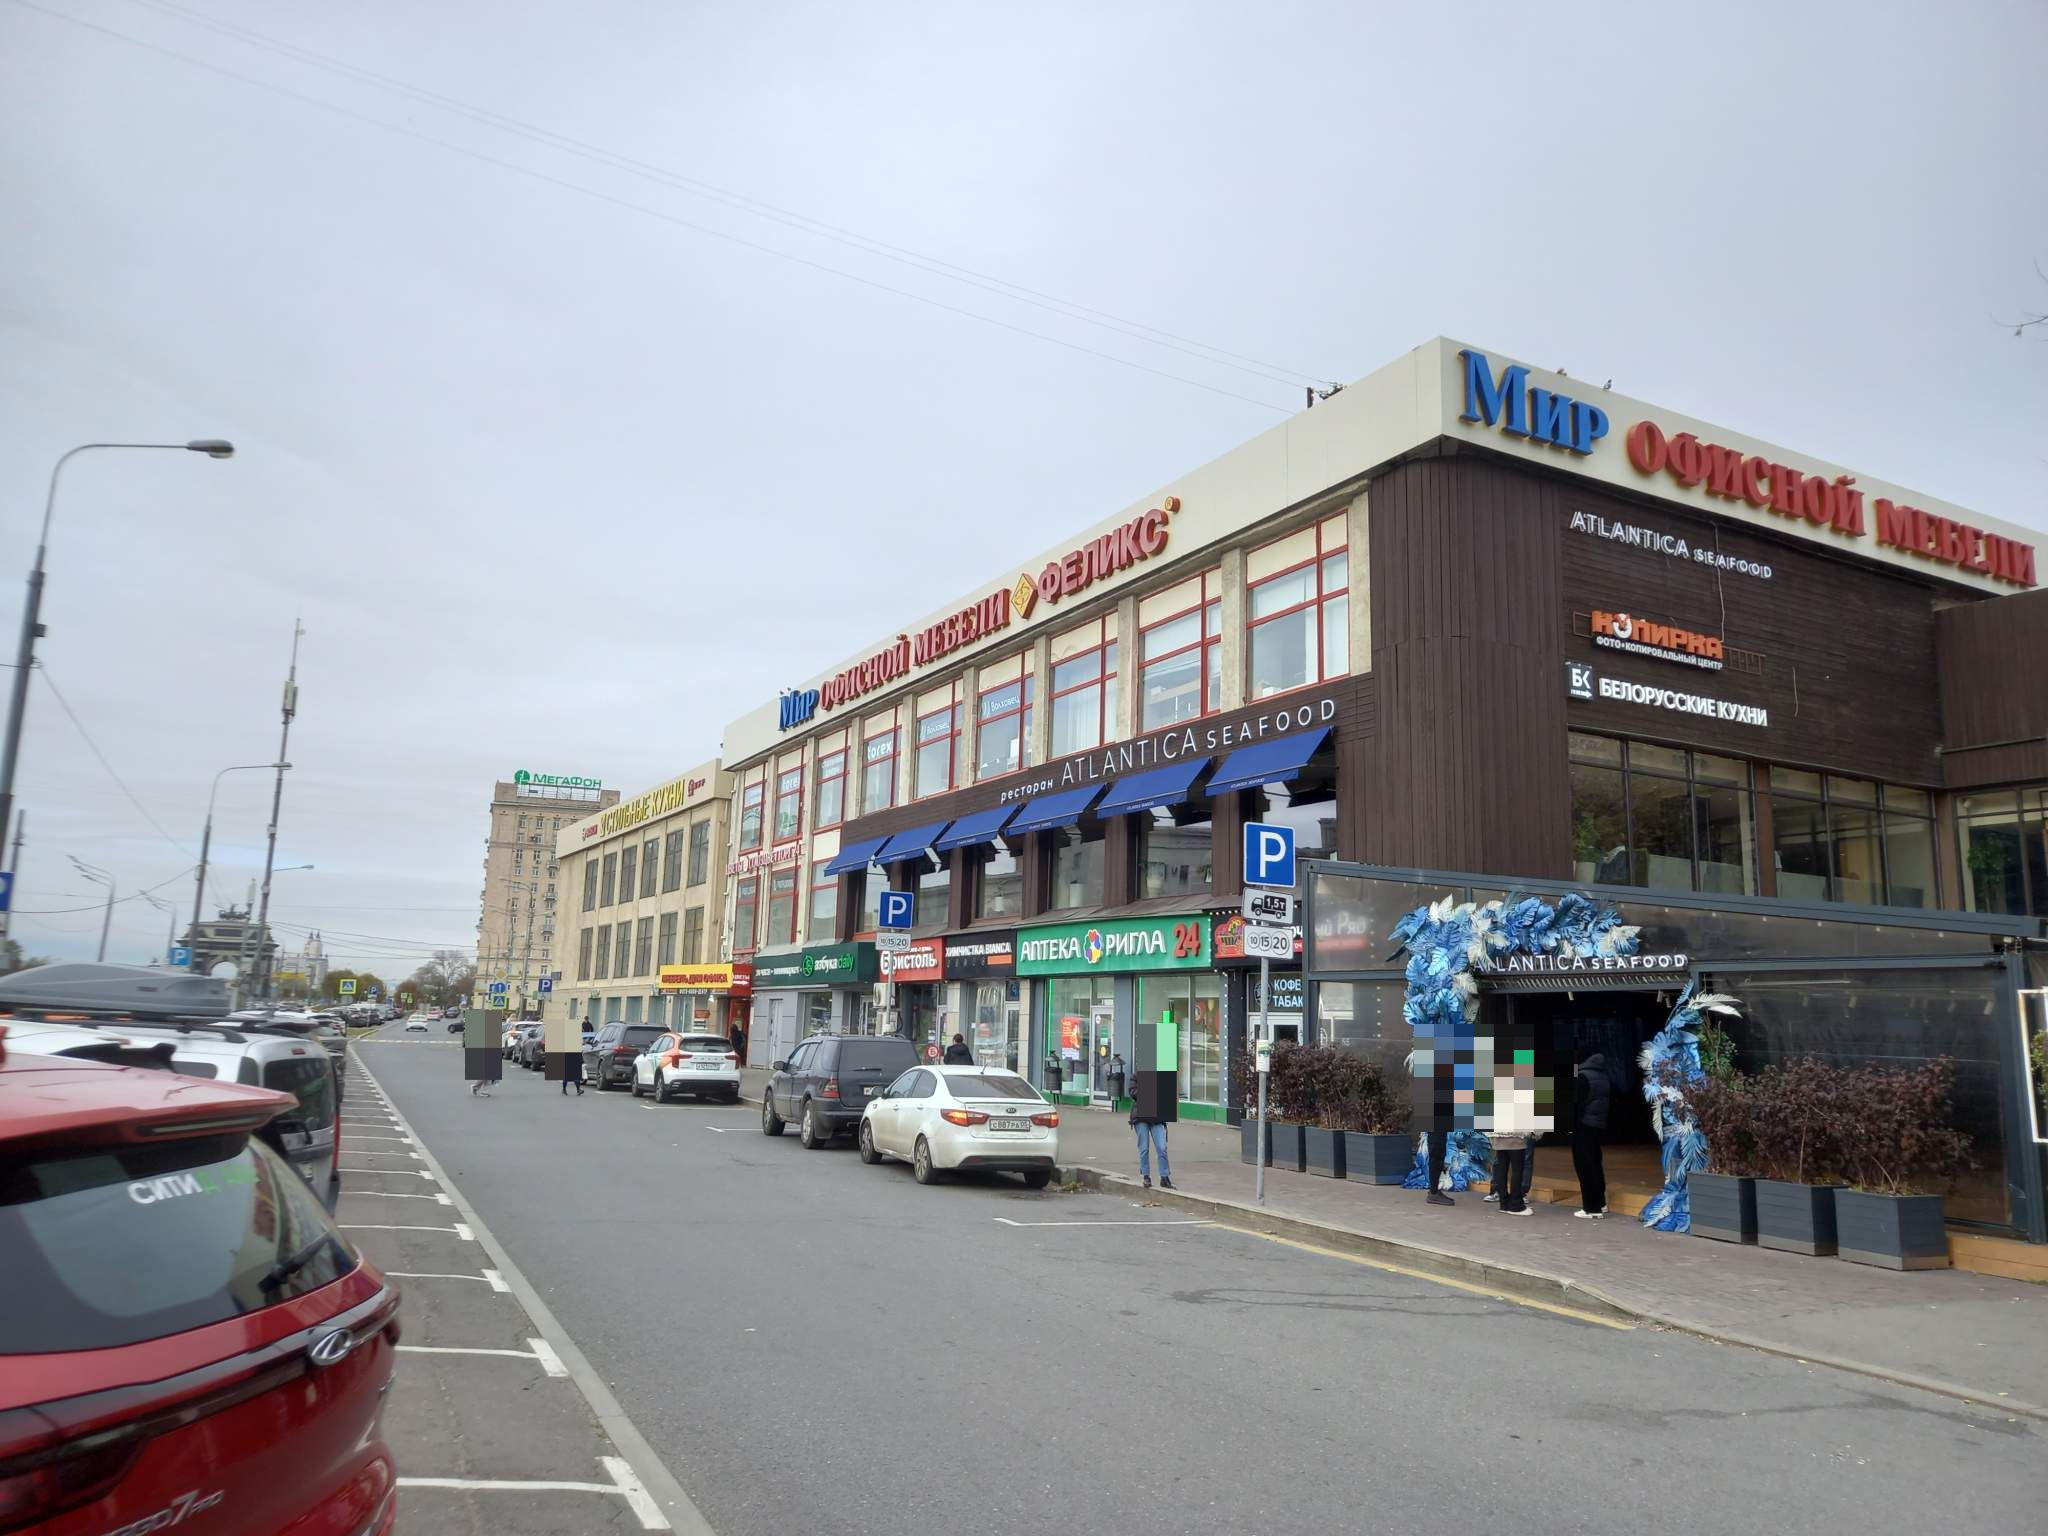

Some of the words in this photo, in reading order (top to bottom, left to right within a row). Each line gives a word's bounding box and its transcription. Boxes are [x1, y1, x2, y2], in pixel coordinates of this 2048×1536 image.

[1627, 420, 1866, 537] ОФИСНОЙ
[1875, 498, 2038, 587] МЕБЕЛИ
[1570, 511, 1689, 558] ATLANTICA
[1694, 549, 1772, 578] SEAFOOD
[819, 634, 911, 711] ОФИСНОЙ
[912, 587, 1011, 667] МЕБЕЛИ
[1037, 508, 1169, 605] ФЕЛИКС
[1698, 657, 1723, 671] ЦЕНТР
[1598, 678, 1717, 717] БЕЛОРУССКИЕ
[1717, 701, 1768, 727] КУХНИ
[1061, 728, 1196, 786] ATLANTICA
[1207, 699, 1335, 749] SEAFOOD
[651, 779, 686, 816] КУХНИ
[1000, 778, 1053, 805] ресторан
[1259, 831, 1286, 878] P
[888, 895, 907, 924] P
[1020, 937, 1081, 962] АПТЕКА
[1105, 930, 1166, 957] РИГЛА
[1173, 922, 1201, 959] 24
[1260, 936, 1270, 947] 15
[1273, 937, 1287, 950] 20
[814, 954, 838, 972] азбука
[1474, 954, 1585, 972] ALANTICA
[1592, 954, 1688, 969] SEAFOOD
[1274, 979, 1302, 991] КОФЕ
